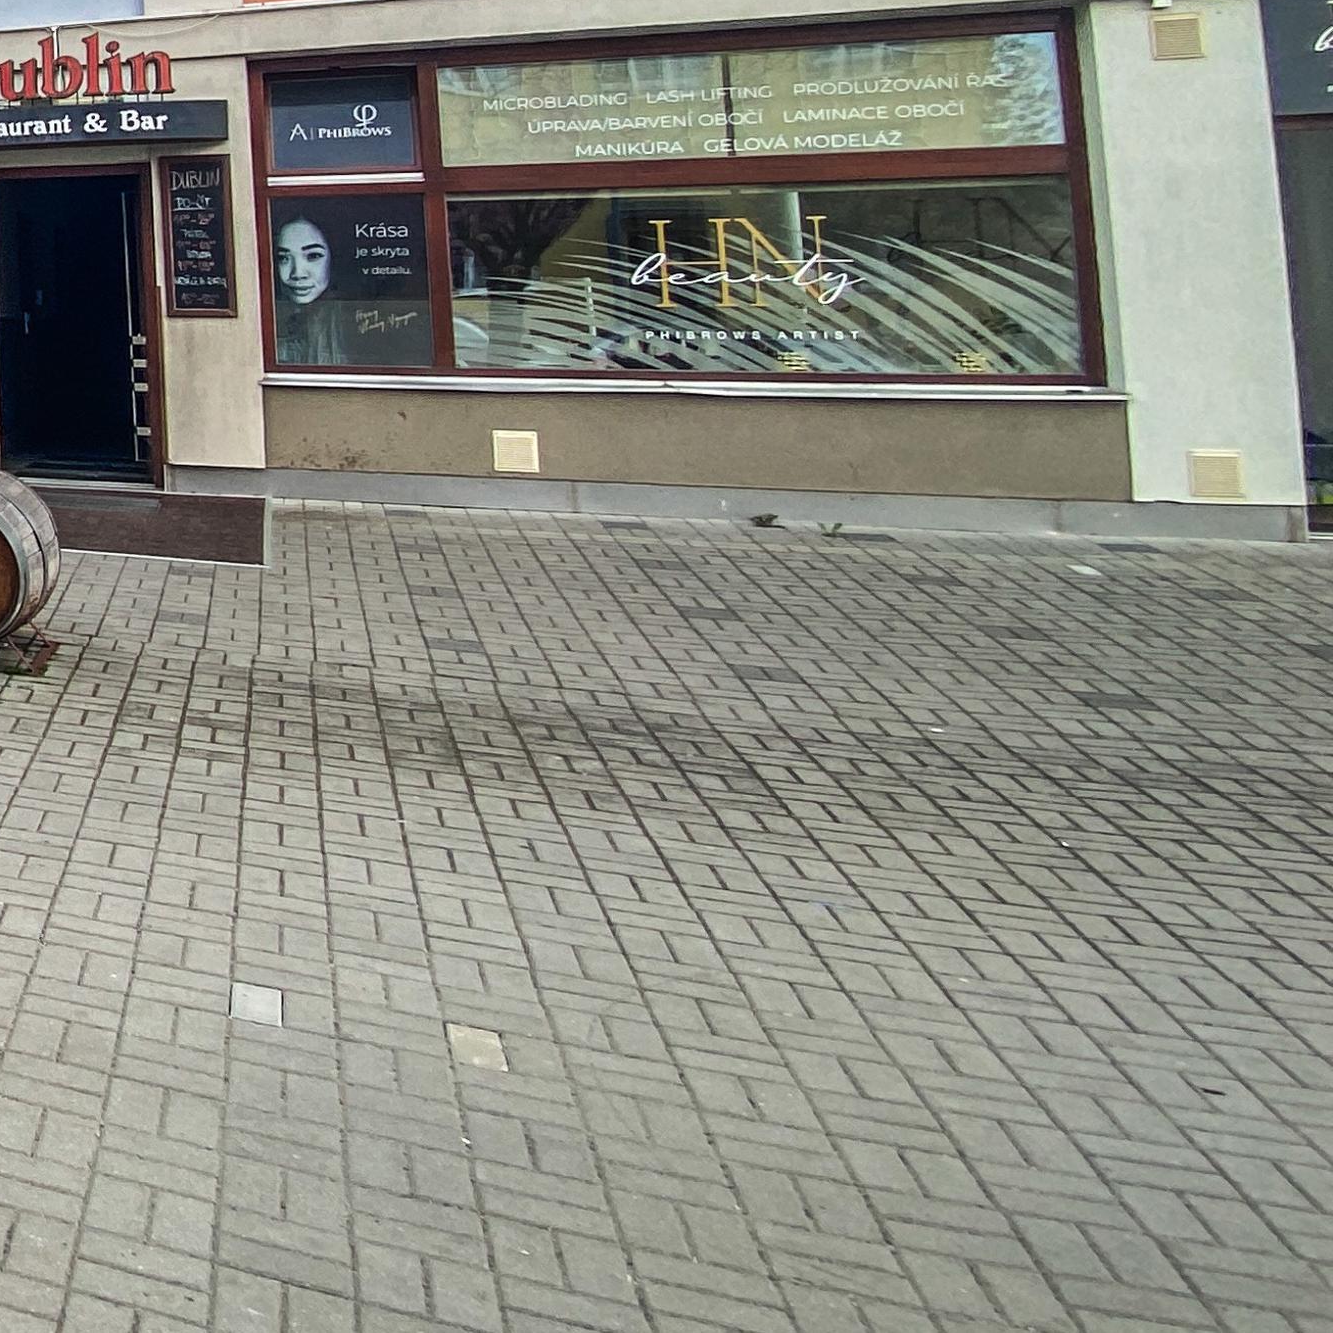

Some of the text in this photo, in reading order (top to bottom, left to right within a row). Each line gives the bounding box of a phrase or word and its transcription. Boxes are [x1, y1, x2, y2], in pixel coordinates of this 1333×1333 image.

[483, 92, 627, 112] MICROBLADING
[645, 89, 695, 103] LASH
[700, 84, 773, 102] LIFTING
[793, 73, 960, 96] PRODLUŽOVÁNÍ
[83, 112, 108, 133] &
[119, 109, 169, 132] Bar
[527, 99, 966, 134] ÚPRAVA/BARVENÍ OBOČÍ LAMINACE OBOČÍ
[703, 133, 789, 153] GELOVÁ
[794, 130, 903, 149] MODELÁŽ
[355, 222, 409, 238] Krása
[355, 246, 410, 258] je skryta
[362, 267, 369, 275] v
[631, 253, 867, 305] beauty
[645, 329, 860, 340] PHIBROWS ARTIST
